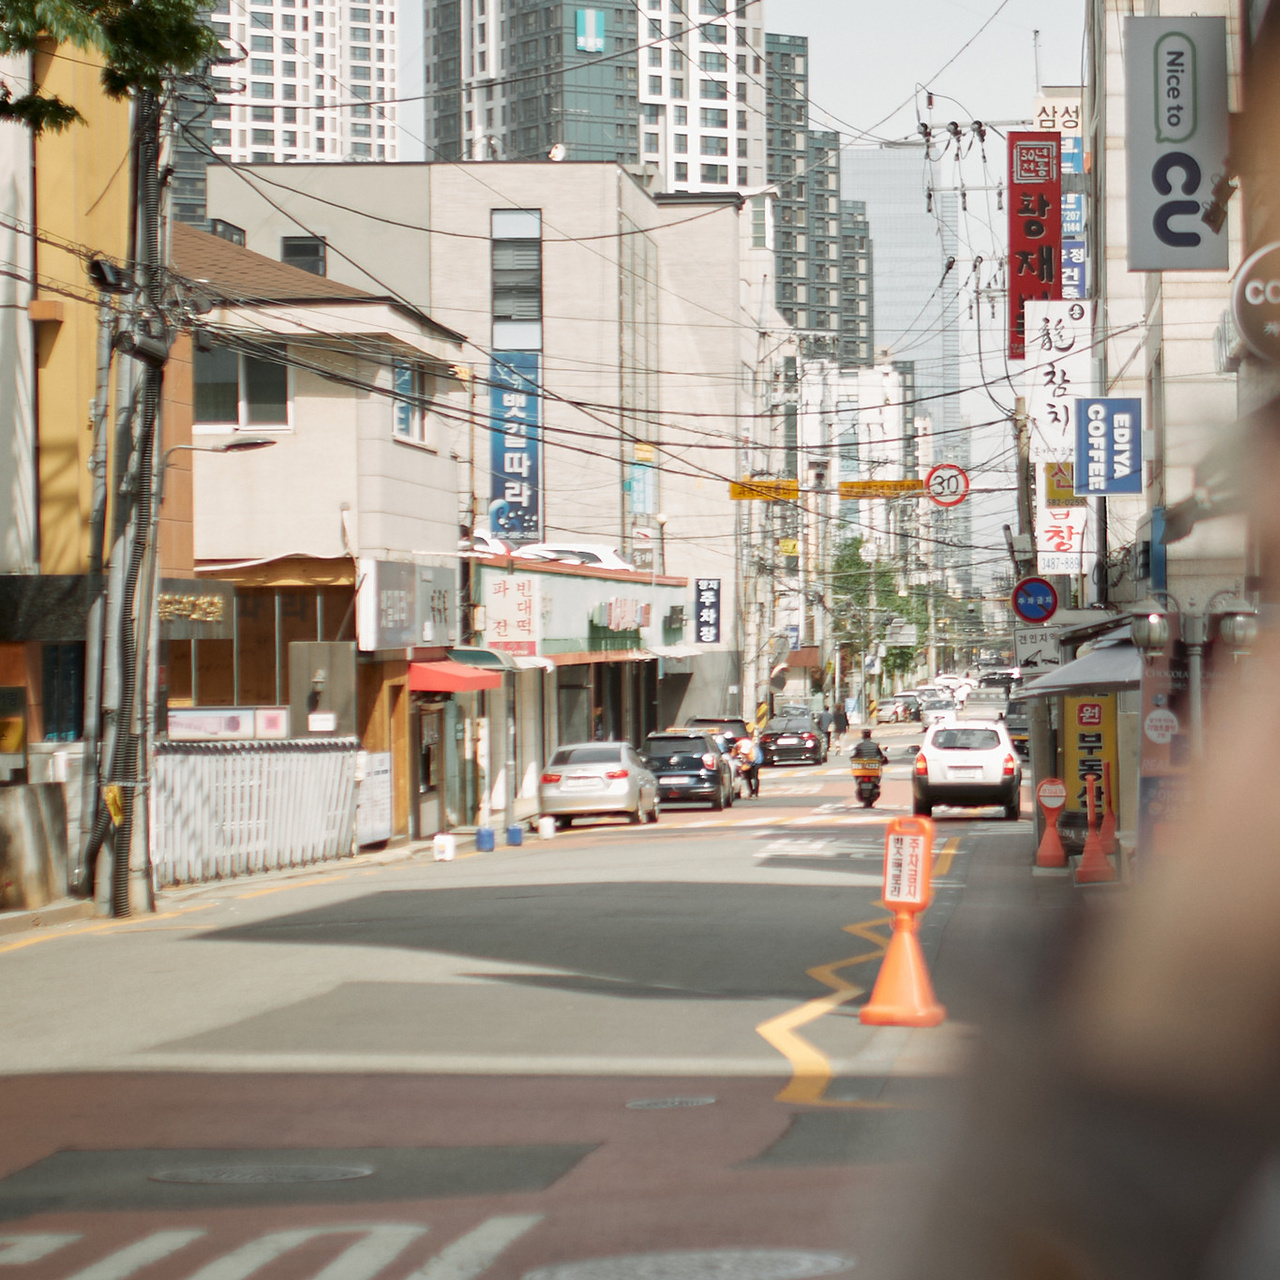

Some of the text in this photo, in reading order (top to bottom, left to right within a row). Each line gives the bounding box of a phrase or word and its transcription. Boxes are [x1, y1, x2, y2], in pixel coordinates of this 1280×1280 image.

[1037, 105, 1080, 129] 삼성
[1166, 50, 1185, 127] Nice to
[1152, 151, 1201, 247] CU
[1087, 403, 1106, 491] COFFEE
[1112, 413, 1131, 480] EDIYA
[930, 474, 959, 495] 30
[516, 579, 533, 636] 빈대떡
[699, 591, 717, 643] 주차장
[1079, 705, 1100, 723] 원
[906, 837, 921, 899] 주차금지
